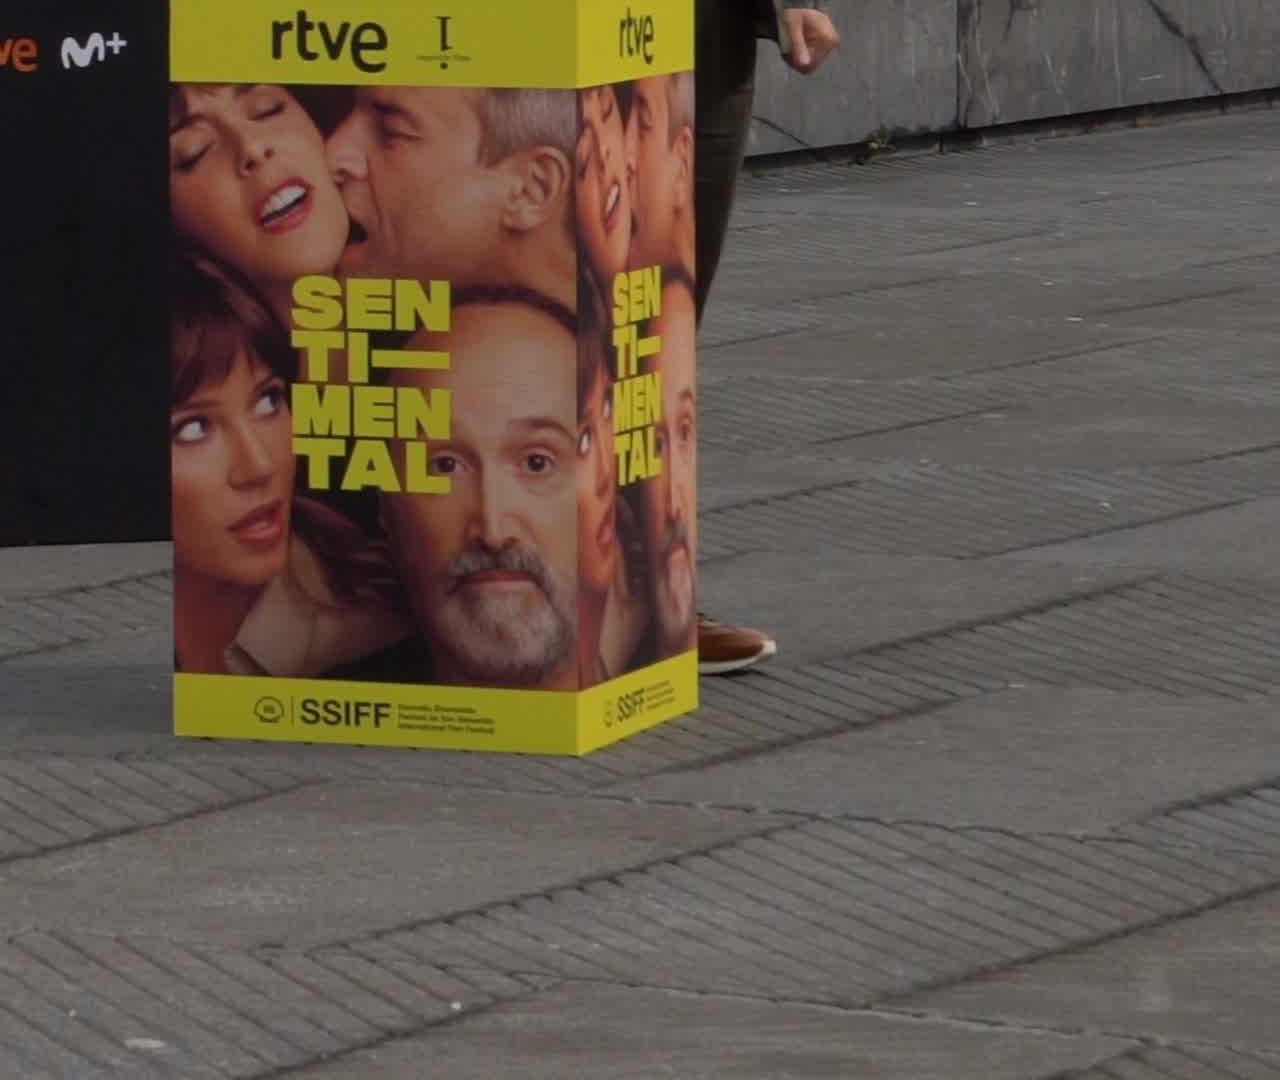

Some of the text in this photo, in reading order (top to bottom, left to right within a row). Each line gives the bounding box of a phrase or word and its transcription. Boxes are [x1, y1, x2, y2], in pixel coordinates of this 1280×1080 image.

[271, 9, 388, 73] rtve
[619, 7, 655, 64] rtve
[291, 275, 452, 332] SEN
[612, 265, 662, 325] SEN
[291, 383, 452, 441] MEN
[612, 372, 662, 434] MEN
[291, 437, 452, 494] TAL
[613, 426, 663, 486] TAL
[301, 698, 392, 728] SSIFF
